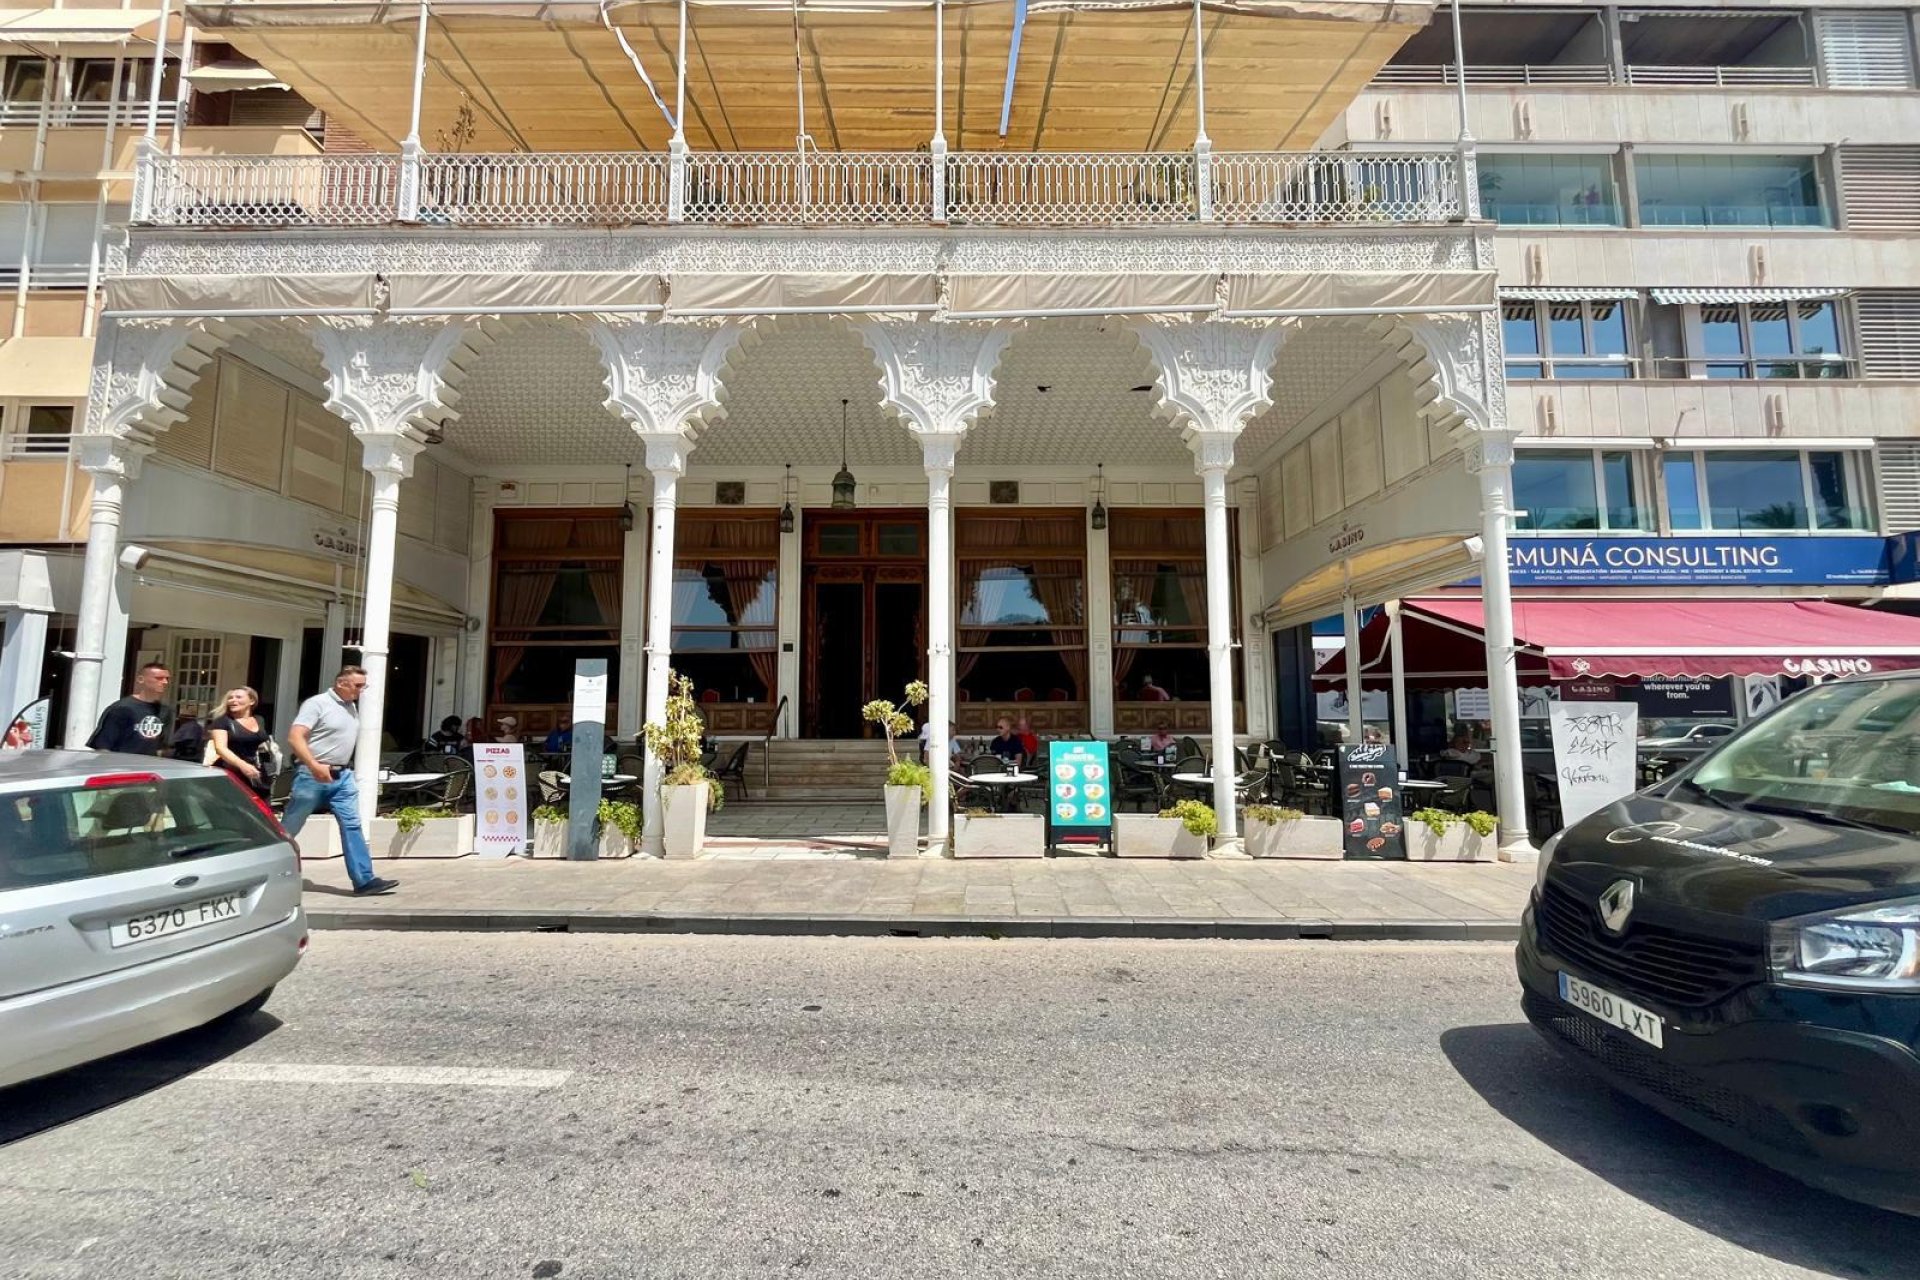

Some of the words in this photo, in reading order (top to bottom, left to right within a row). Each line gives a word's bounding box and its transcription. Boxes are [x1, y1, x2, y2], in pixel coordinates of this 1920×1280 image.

[1329, 529, 1364, 553] CASINO
[1605, 546, 1779, 567] CONSULTING
[1782, 658, 1872, 673] CASINO
[1571, 685, 1611, 694] CASINO
[1643, 682, 1684, 690] wherever
[1685, 682, 1711, 693] you're
[1666, 689, 1700, 699] from.
[485, 747, 511, 755] PIZZAS
[127, 908, 186, 938] 6370
[200, 896, 236, 921] FKX
[1570, 981, 1613, 1018] 5960
[1619, 1003, 1656, 1039] LXT
